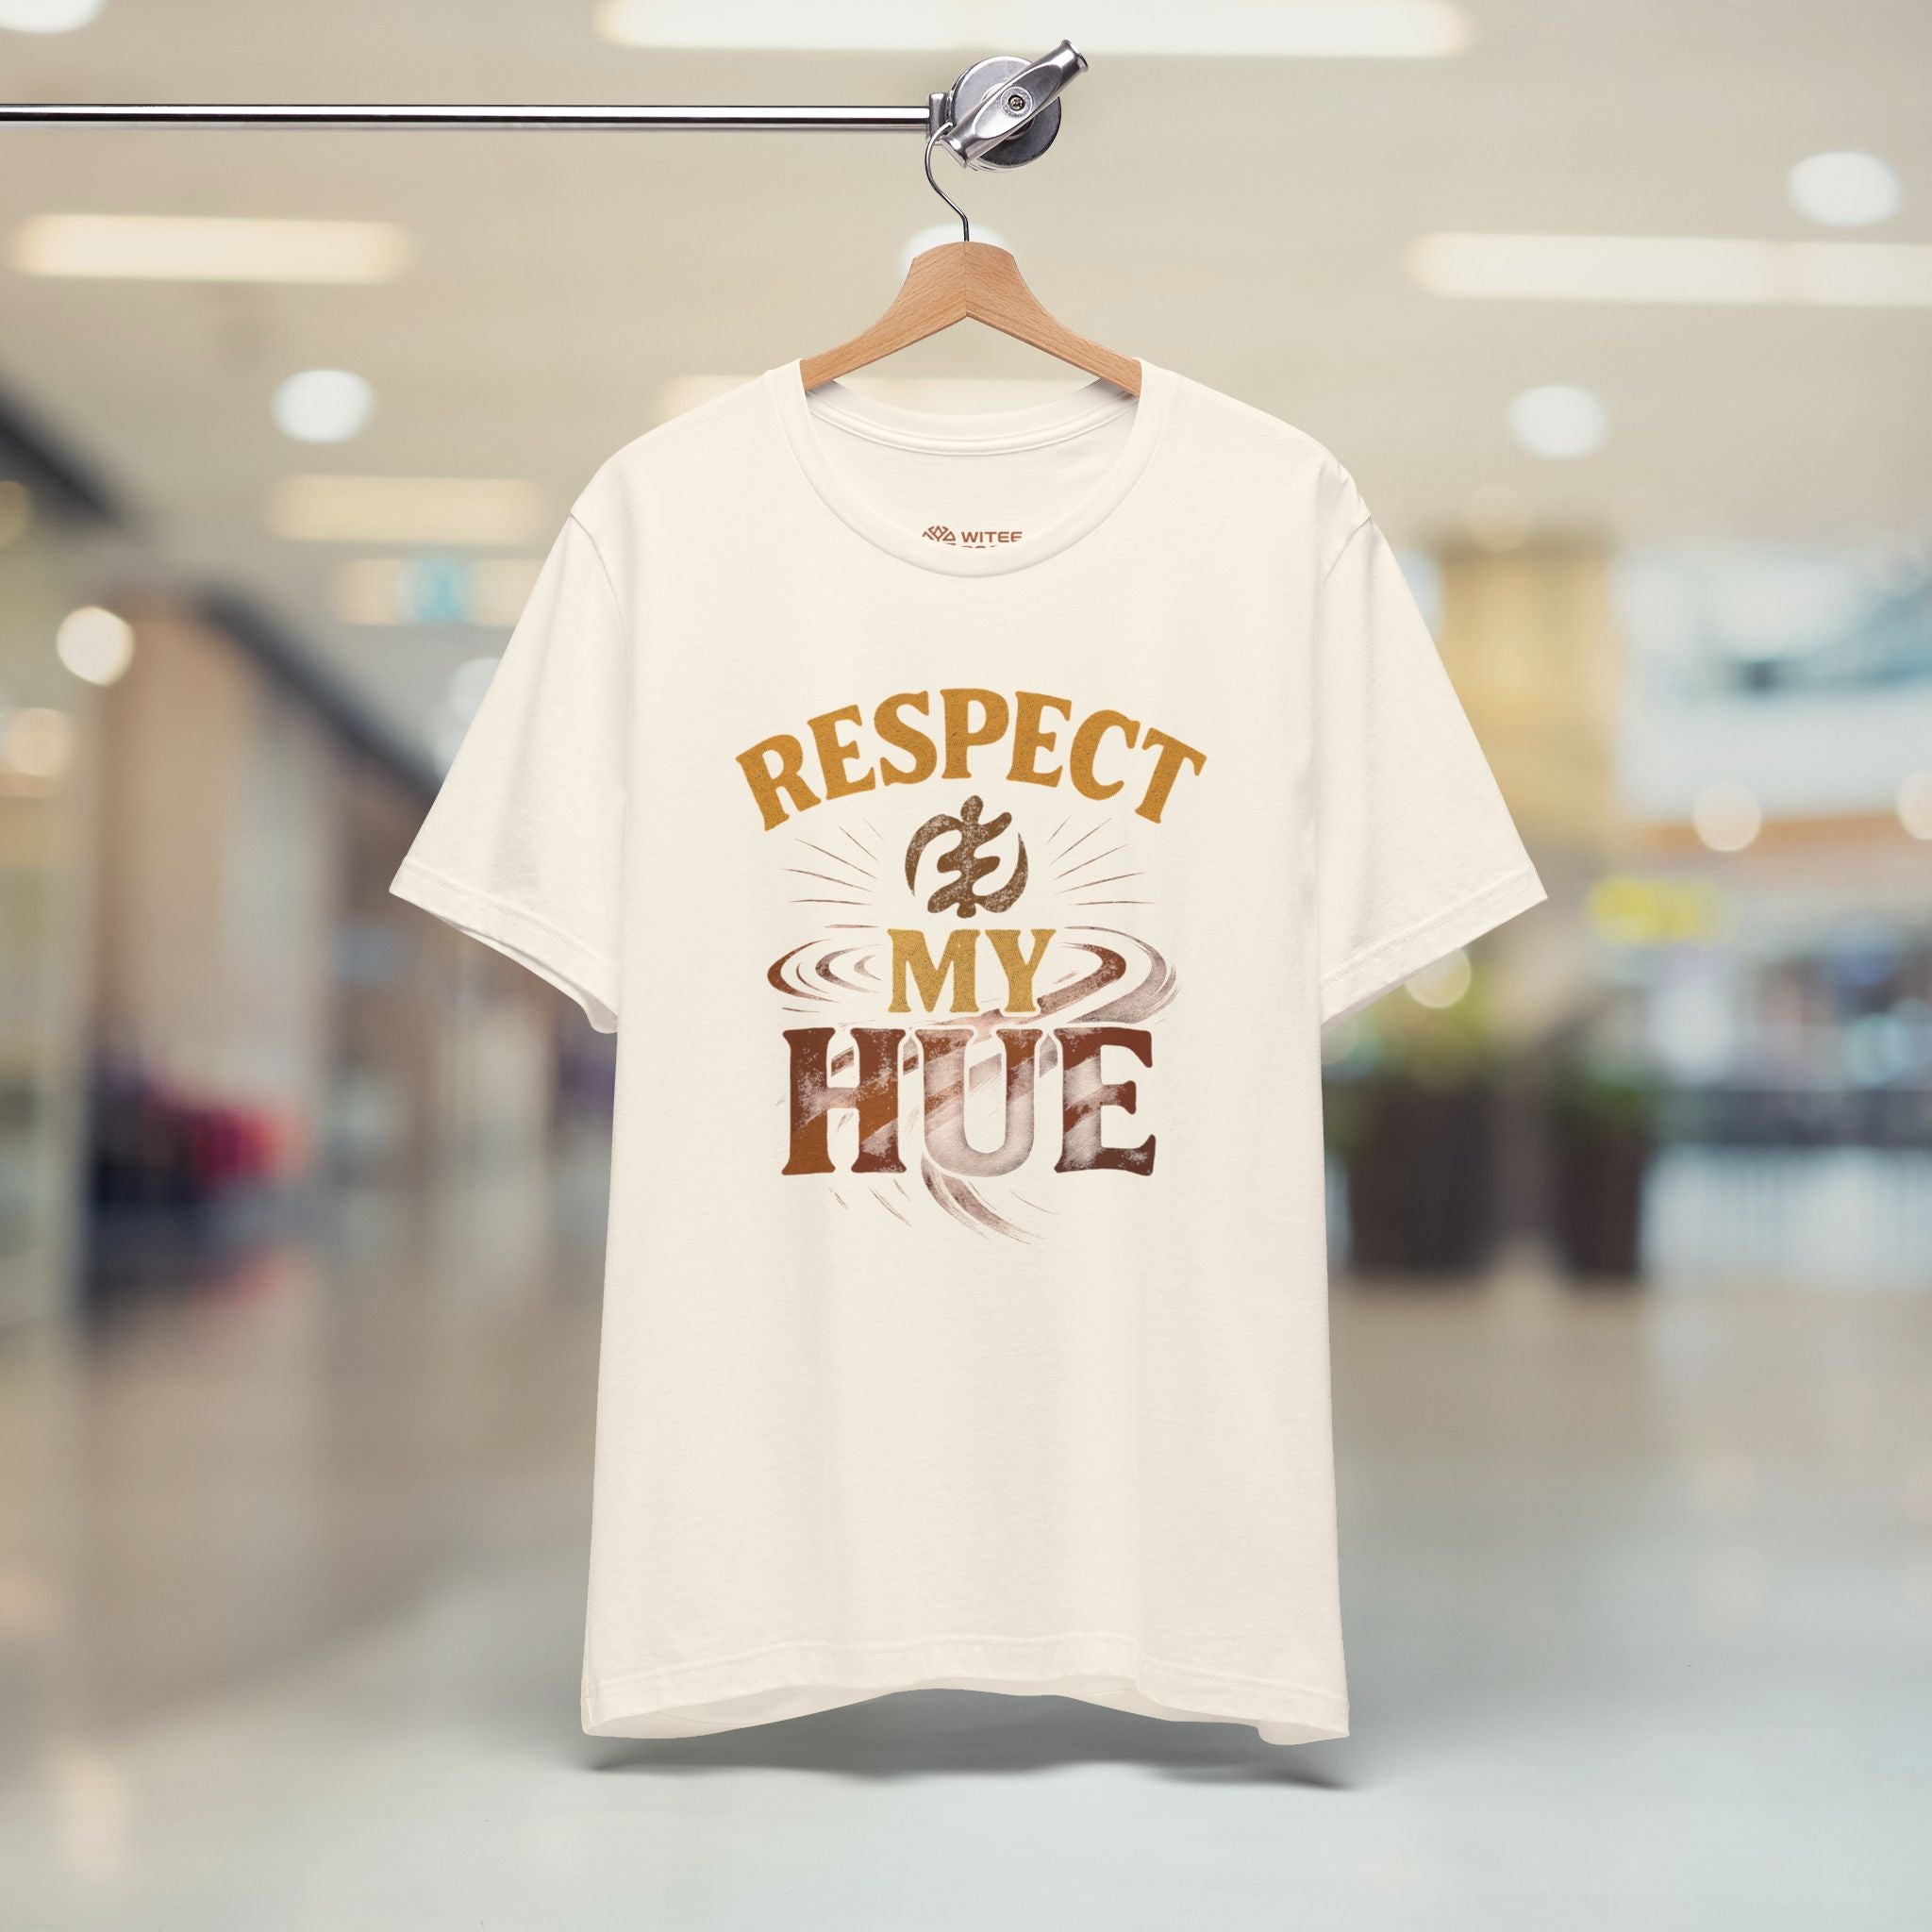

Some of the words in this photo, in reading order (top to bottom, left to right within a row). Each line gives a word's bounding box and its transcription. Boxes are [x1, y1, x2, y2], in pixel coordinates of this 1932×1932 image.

[735, 689, 1207, 832] RESPECT
[887, 928, 1057, 1013] MY
[781, 1026, 1157, 1177] HUE
